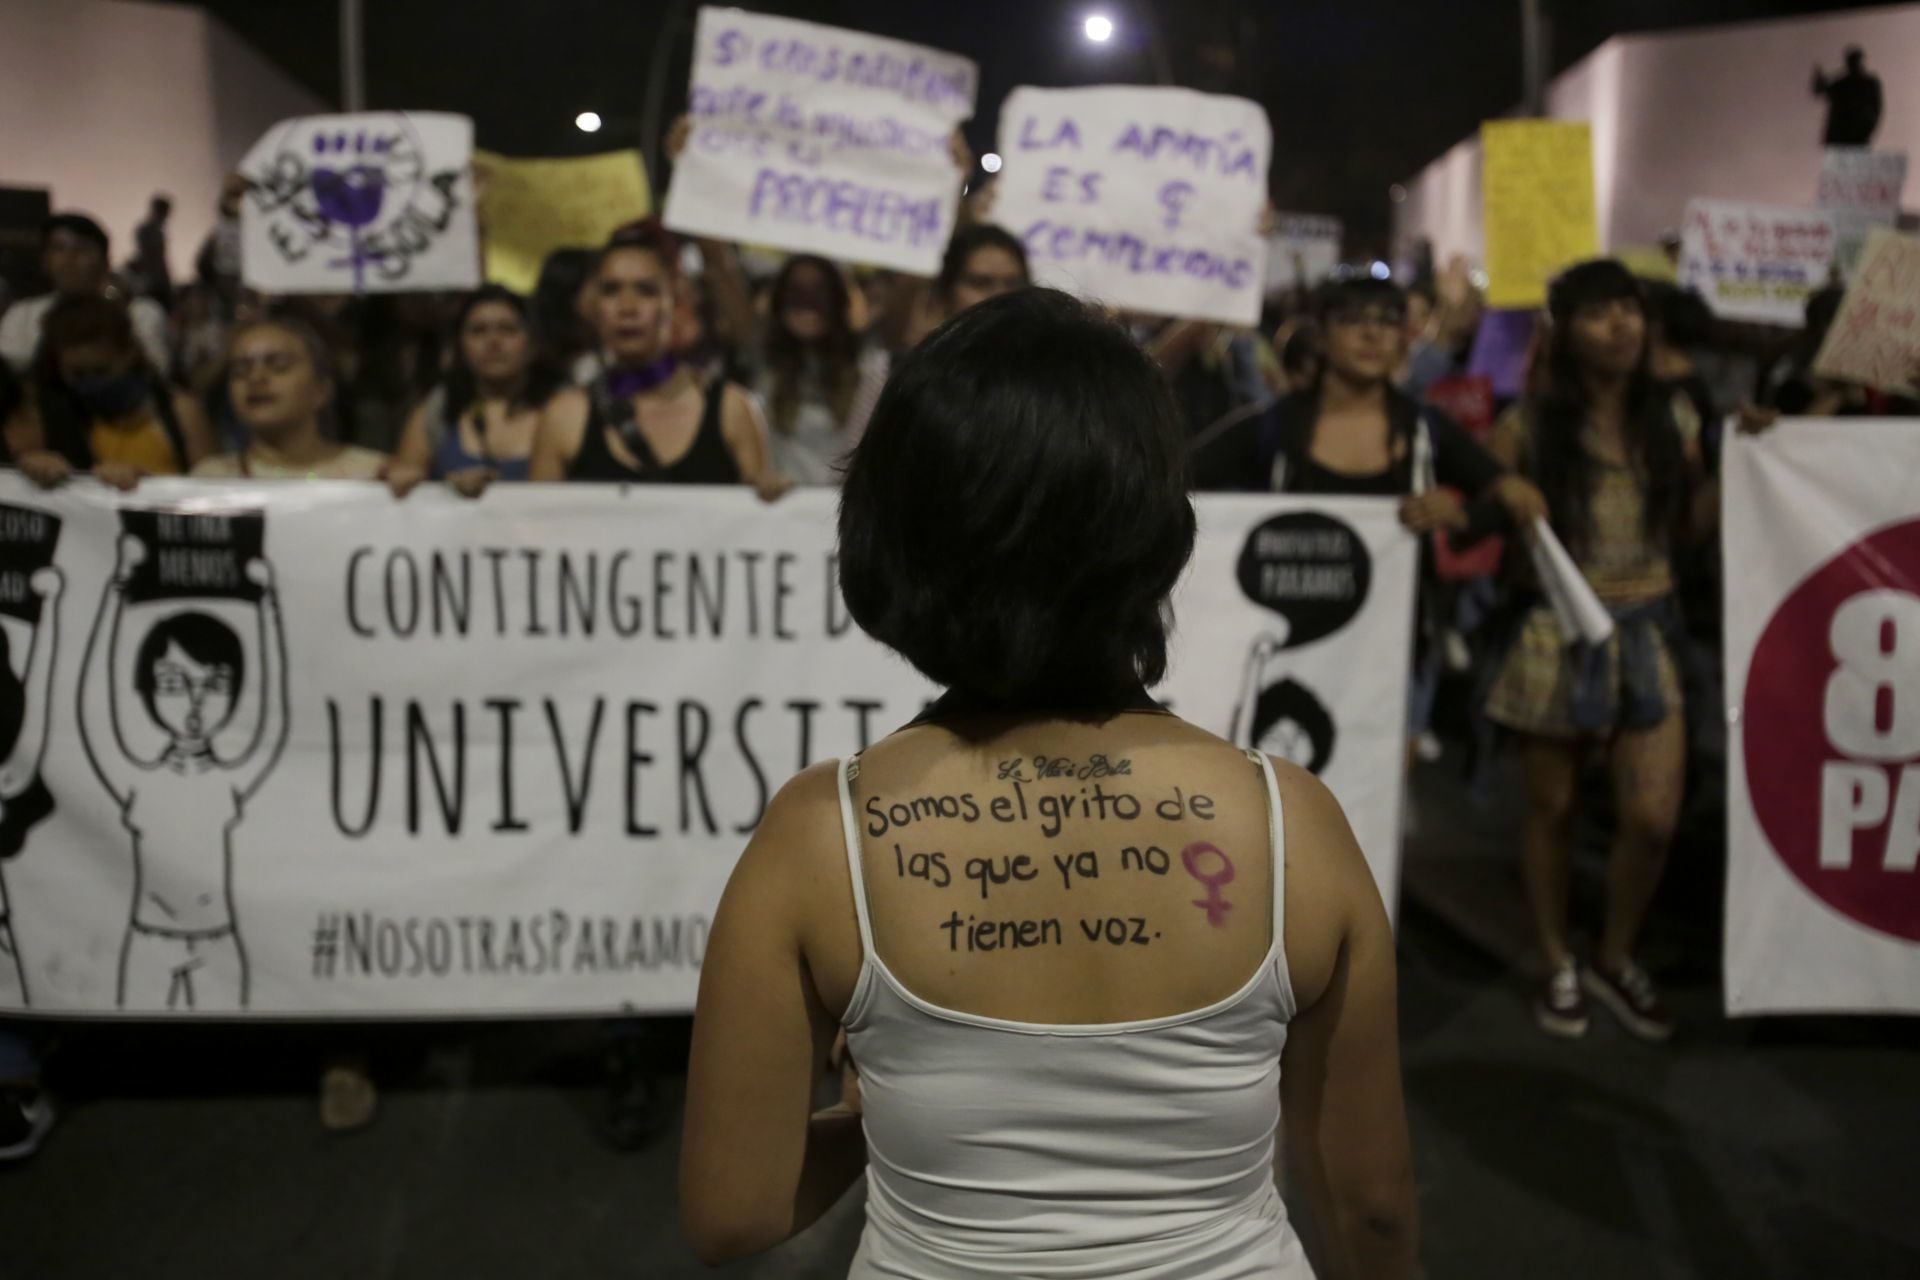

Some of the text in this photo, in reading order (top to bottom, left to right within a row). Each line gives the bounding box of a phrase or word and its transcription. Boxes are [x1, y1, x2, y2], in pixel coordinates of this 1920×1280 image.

[1018, 116, 1082, 151] LA
[1042, 166, 1104, 203] ES
[157, 549, 241, 588] MENOS
[345, 545, 800, 640] CONTINGENTE
[866, 781, 1216, 838] Somos el grito de
[894, 843, 1171, 899] las que ya no
[939, 910, 1163, 953] tienen voz.
